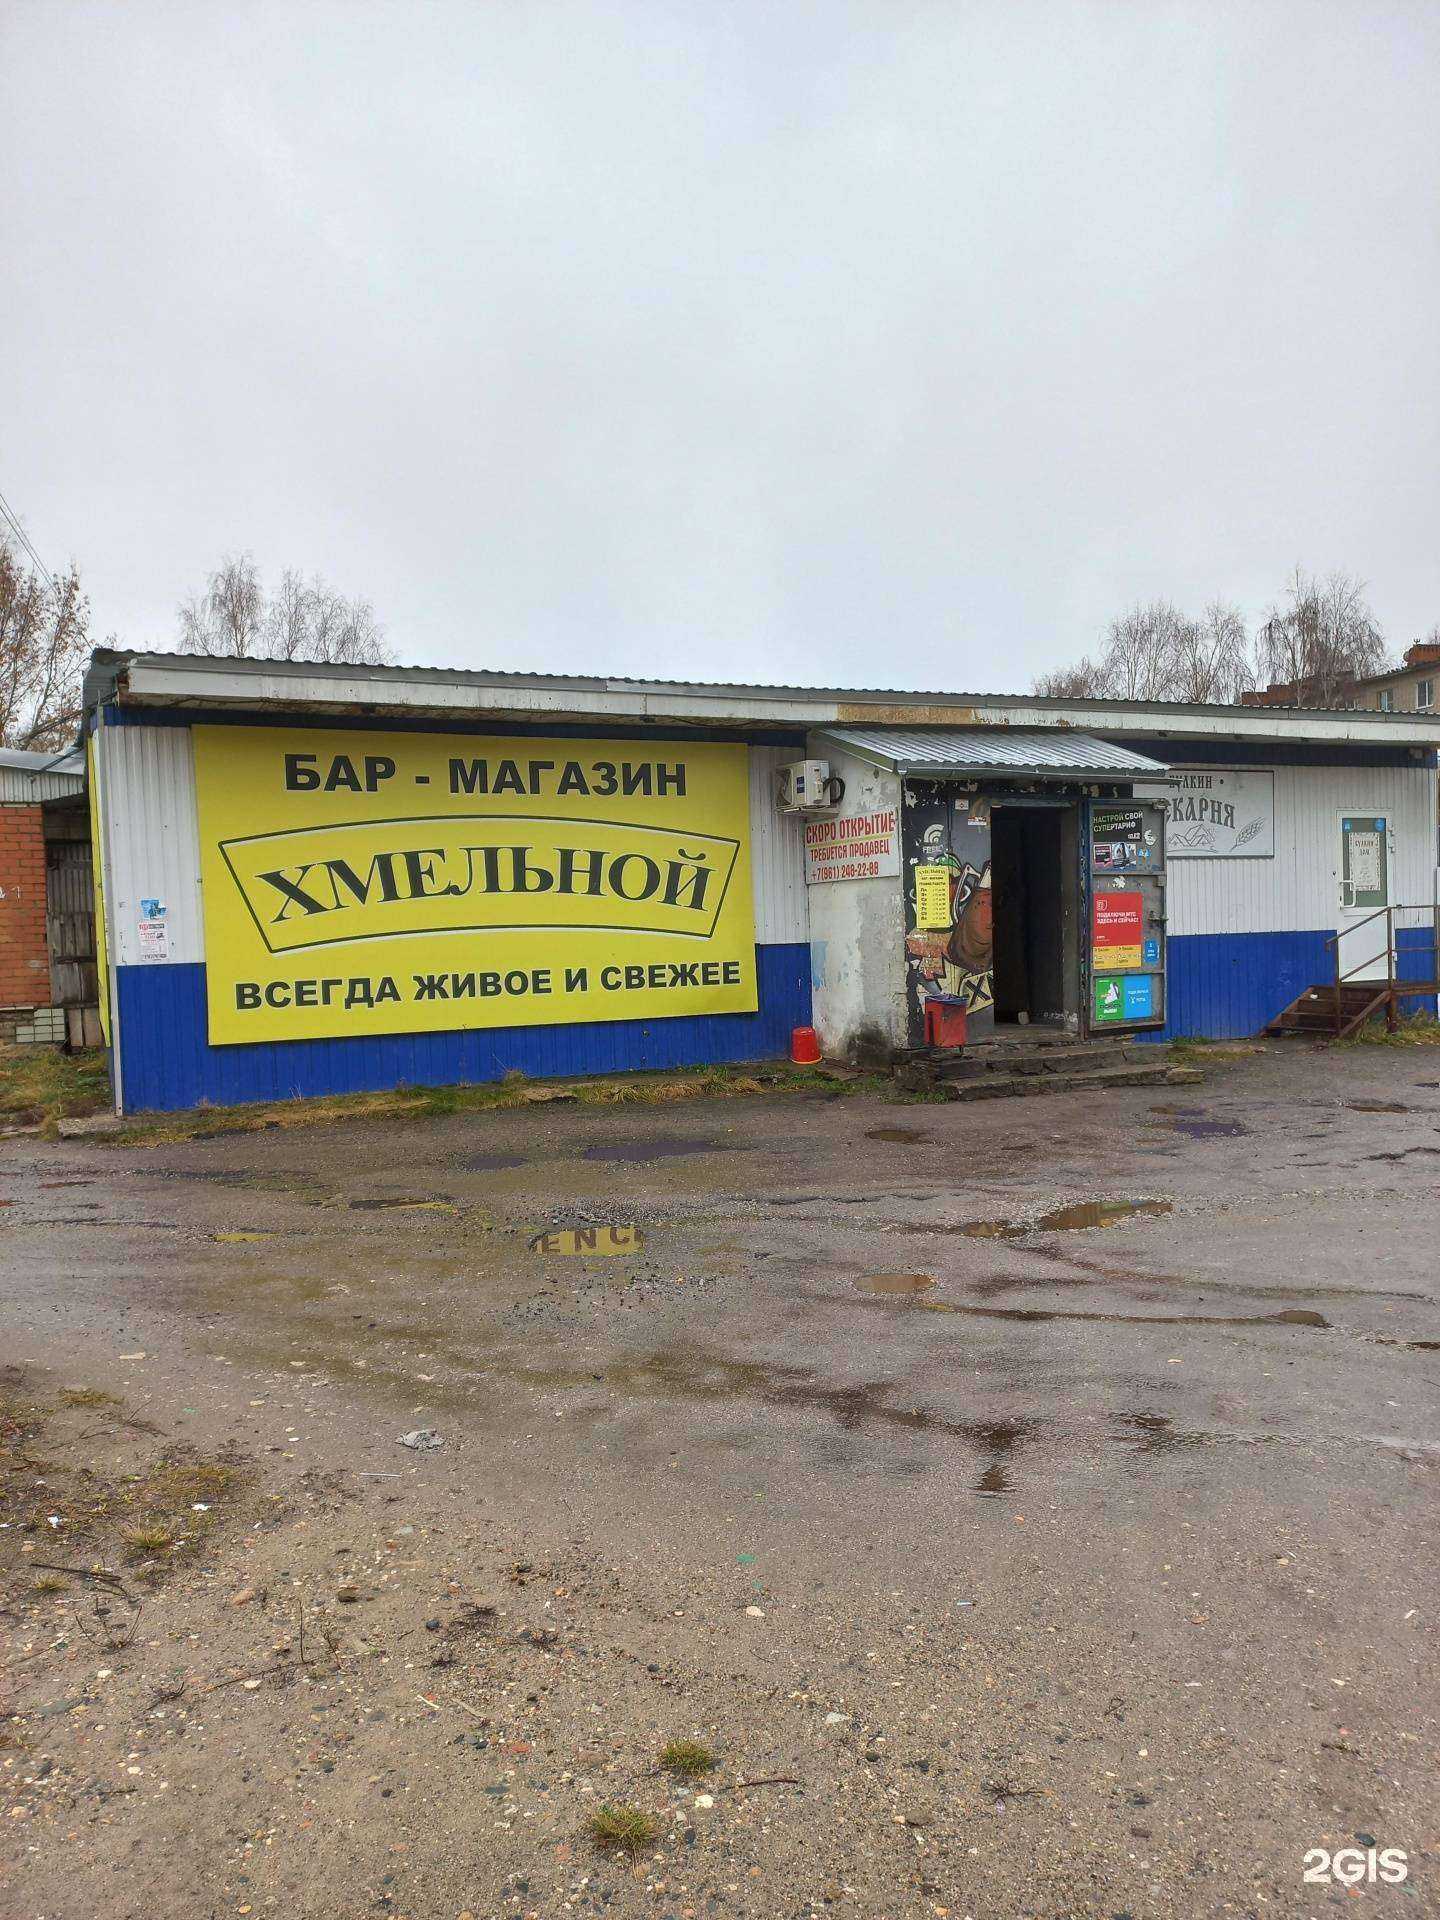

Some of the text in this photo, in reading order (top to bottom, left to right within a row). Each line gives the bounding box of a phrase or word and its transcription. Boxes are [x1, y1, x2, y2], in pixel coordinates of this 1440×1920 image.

[284, 753, 396, 792] БАР
[448, 758, 687, 796] МАГАЗИН
[806, 811, 895, 844] СКОРО ОТКРЫТИЕ
[1093, 821, 1136, 832] СУПЕРТАРИФ
[811, 838, 890, 862] ТРЕБУЕТСЯ ПРОДАВЕЦ
[255, 846, 714, 924] ХМЕЛЬНОЙ
[235, 960, 741, 1010] ВСЕГДА ЖИВОЕ И СВЕЖЕЕ
